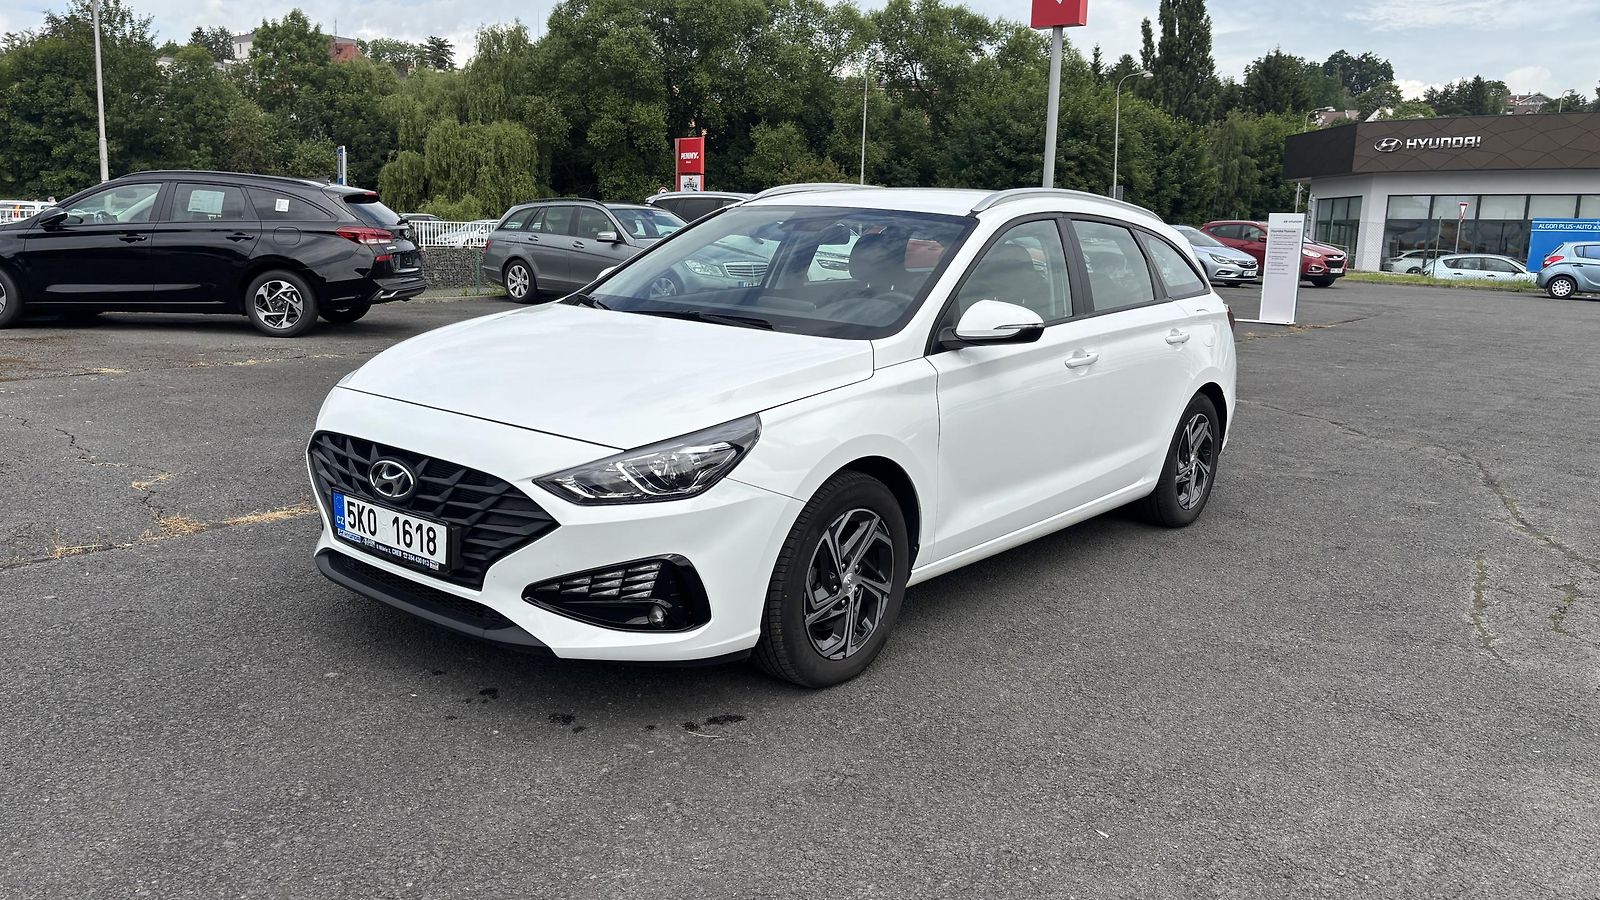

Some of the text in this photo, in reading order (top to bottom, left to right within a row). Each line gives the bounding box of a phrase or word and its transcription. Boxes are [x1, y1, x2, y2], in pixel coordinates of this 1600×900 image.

[1406, 136, 1481, 150] HYUNDAI
[336, 515, 345, 525] CZ
[392, 516, 437, 557] 1618
